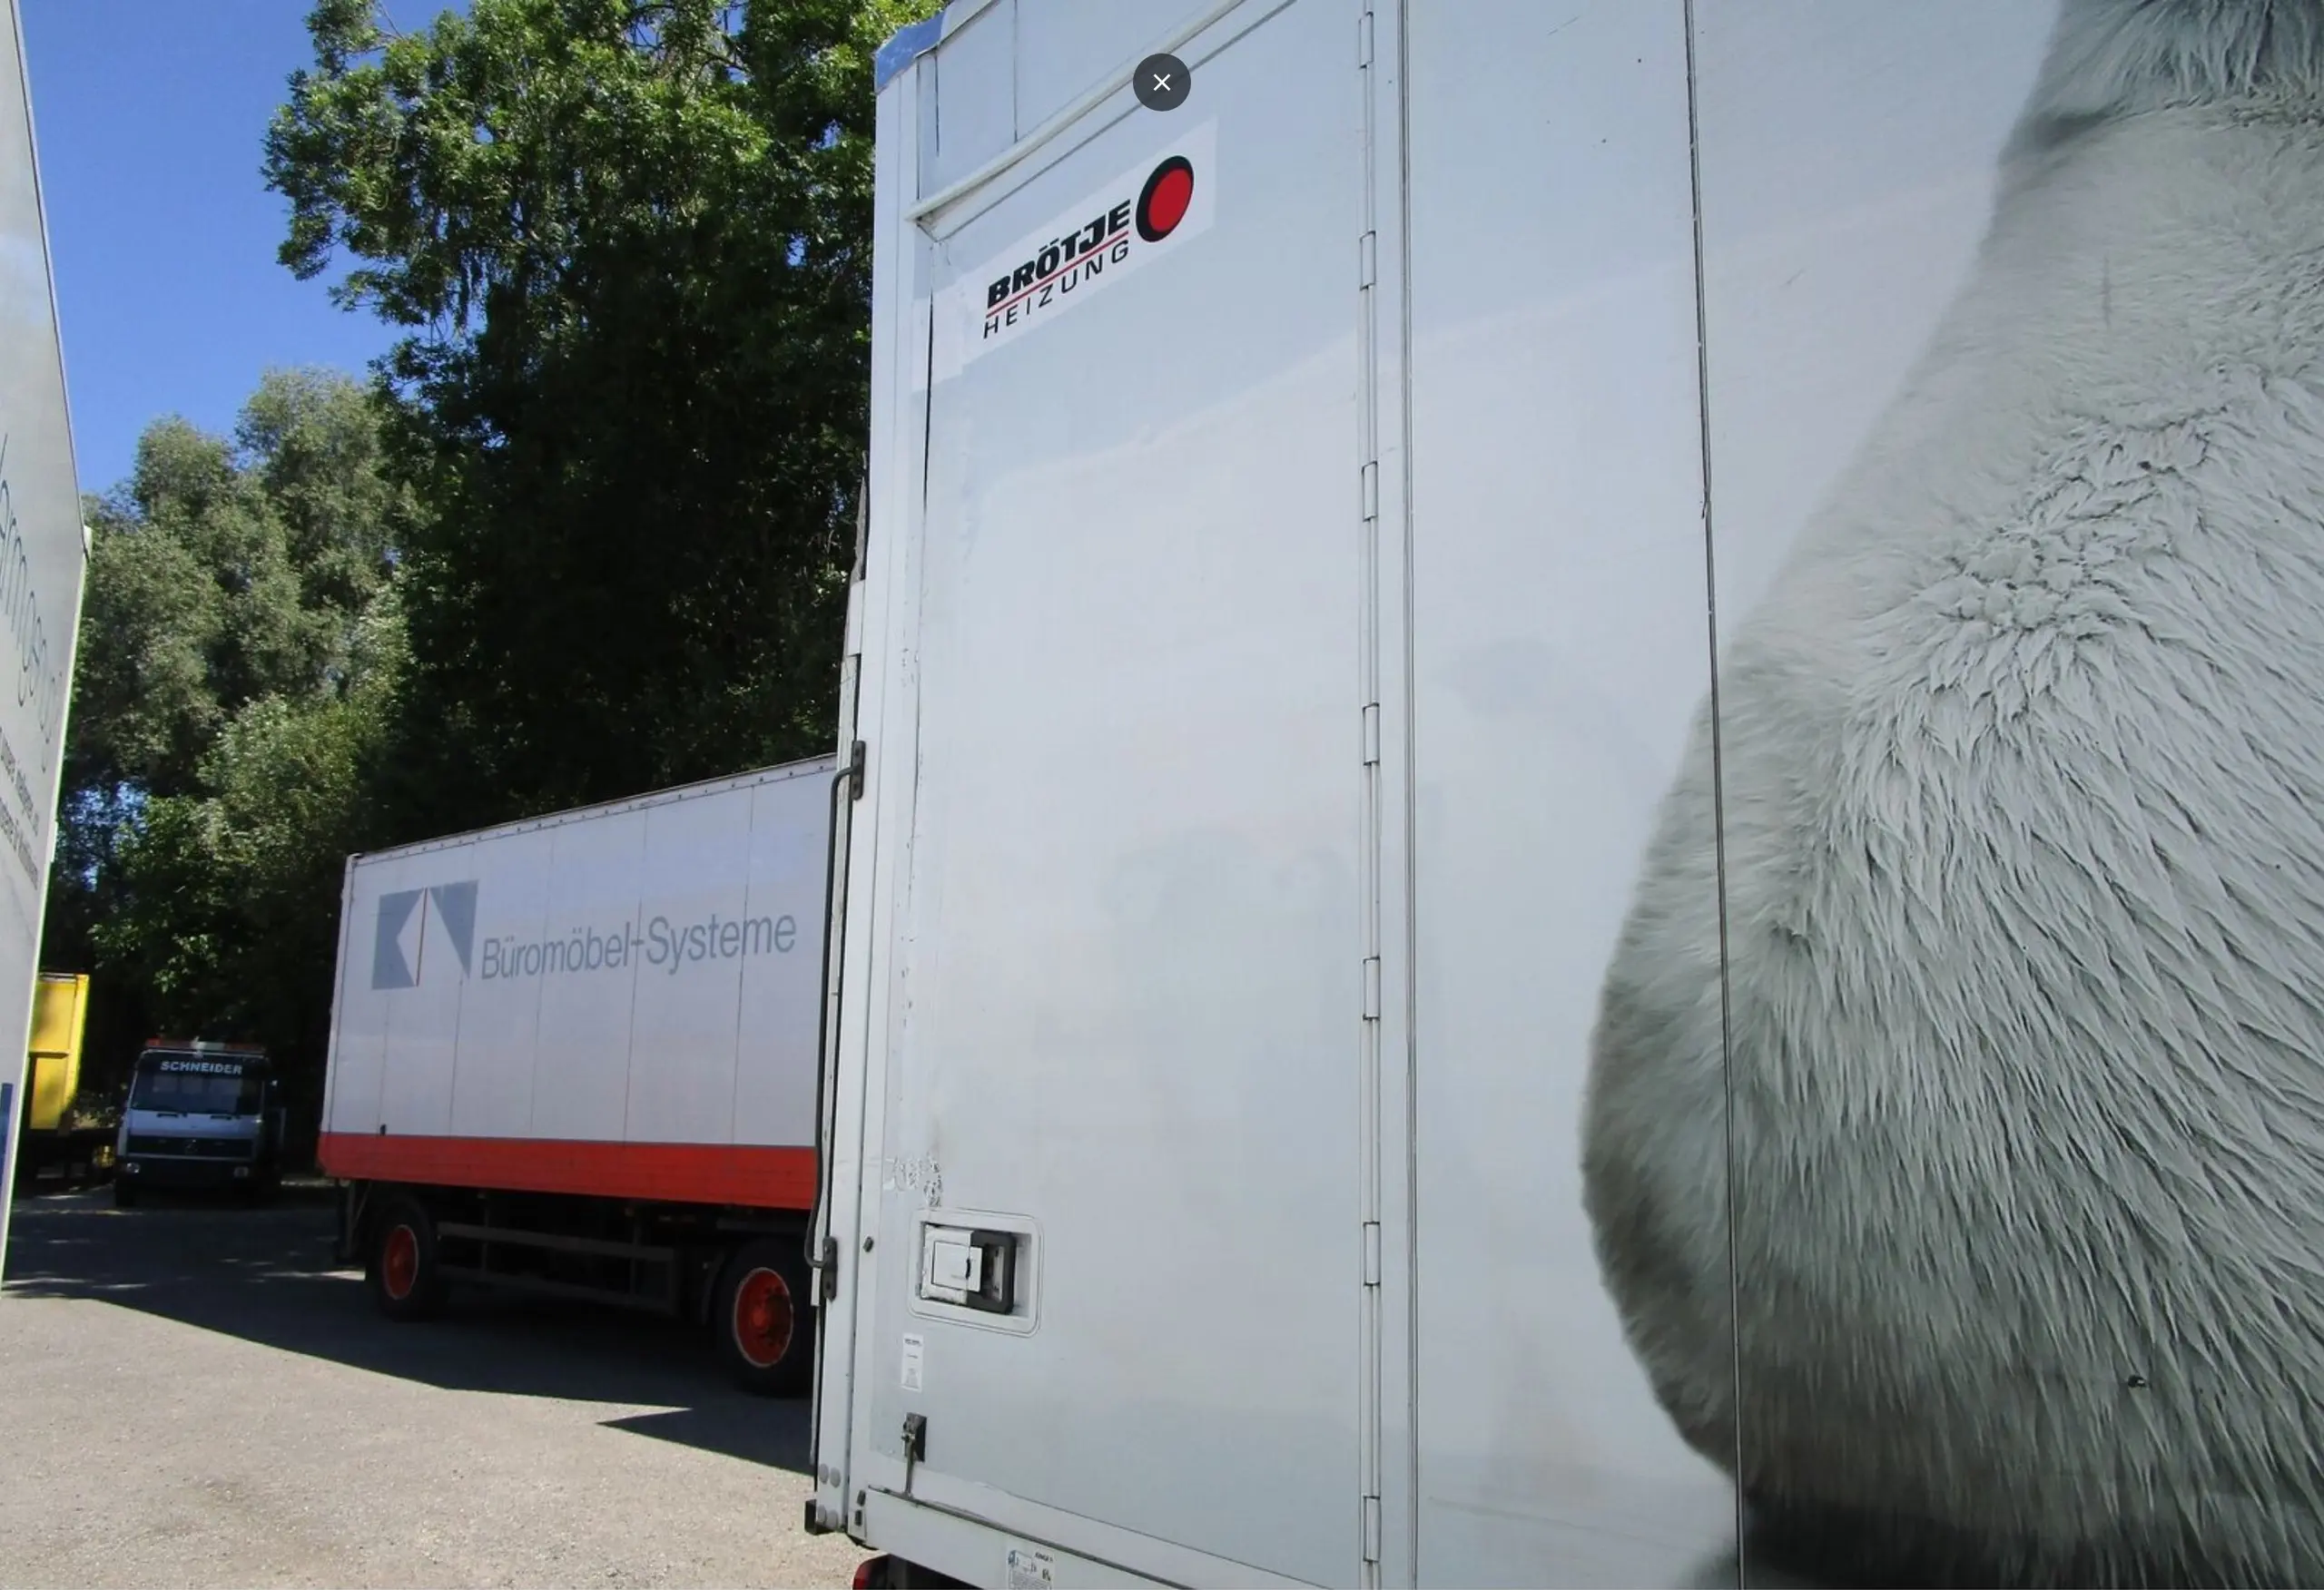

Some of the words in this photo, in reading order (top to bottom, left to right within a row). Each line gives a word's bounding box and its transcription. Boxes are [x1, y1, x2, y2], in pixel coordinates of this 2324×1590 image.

[983, 240, 1128, 339] HEIZUNG
[987, 199, 1131, 309] BRÖTJE
[481, 913, 797, 980] Büromöbel-Systeme
[161, 1061, 242, 1075] SCHNEIDER
